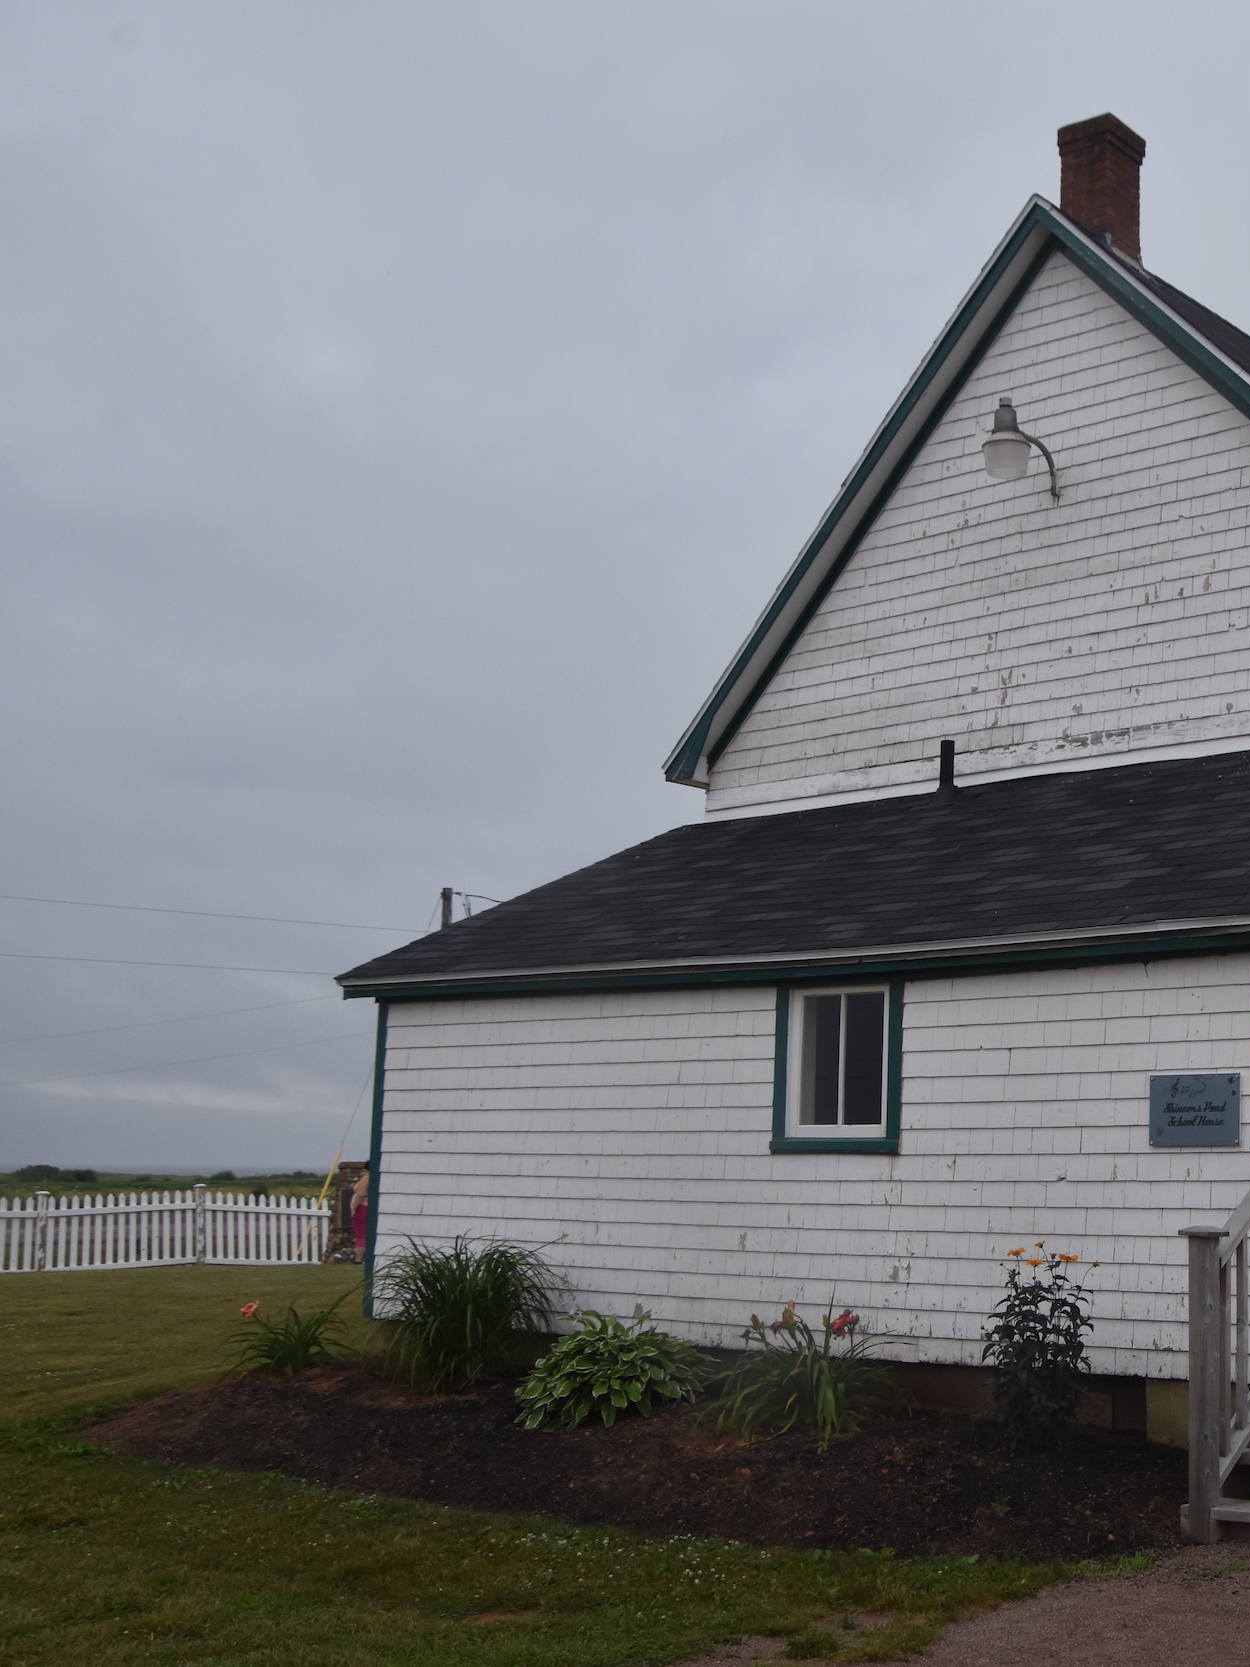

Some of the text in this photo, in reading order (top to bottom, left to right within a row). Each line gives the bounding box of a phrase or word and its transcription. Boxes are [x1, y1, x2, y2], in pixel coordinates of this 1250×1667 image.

[1164, 1101, 1227, 1114] Skinners Pond
[1167, 1115, 1224, 1126] School House
